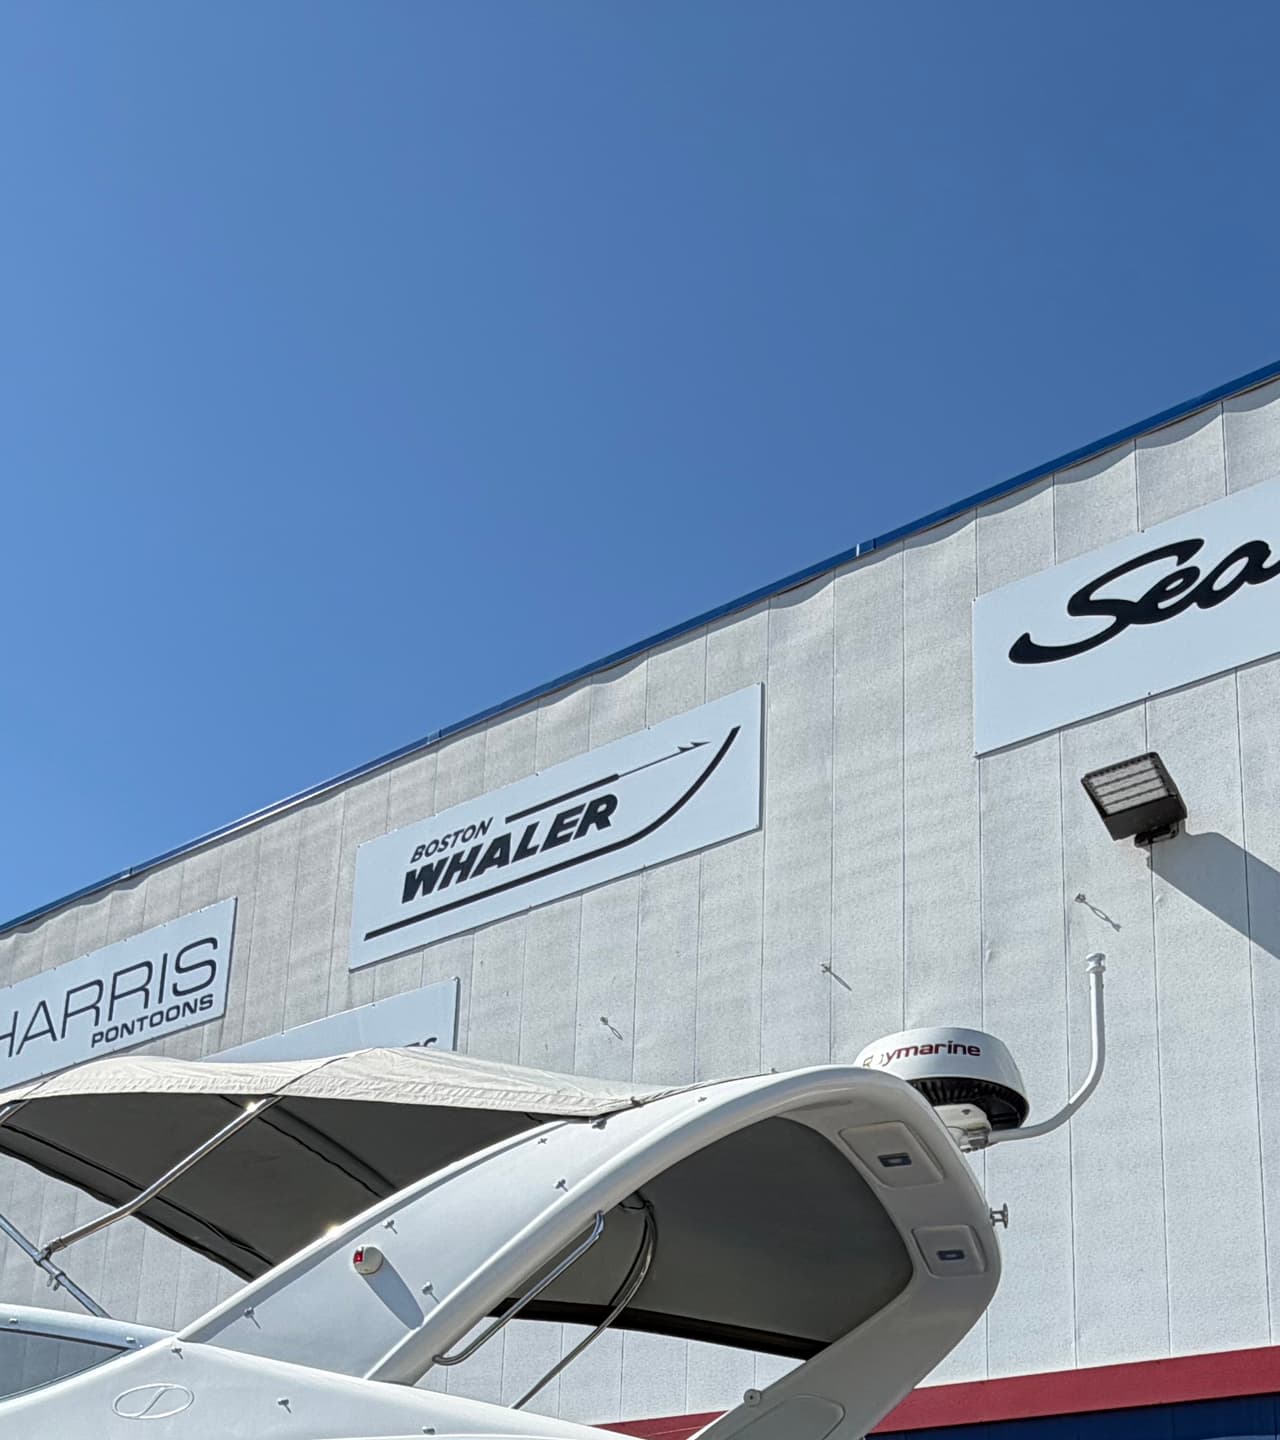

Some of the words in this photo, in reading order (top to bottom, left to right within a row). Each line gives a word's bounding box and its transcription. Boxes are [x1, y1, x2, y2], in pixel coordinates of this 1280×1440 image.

[401, 793, 618, 904] WHALER
[409, 816, 494, 864] BOSTON
[91, 993, 214, 1049] PONTOONS
